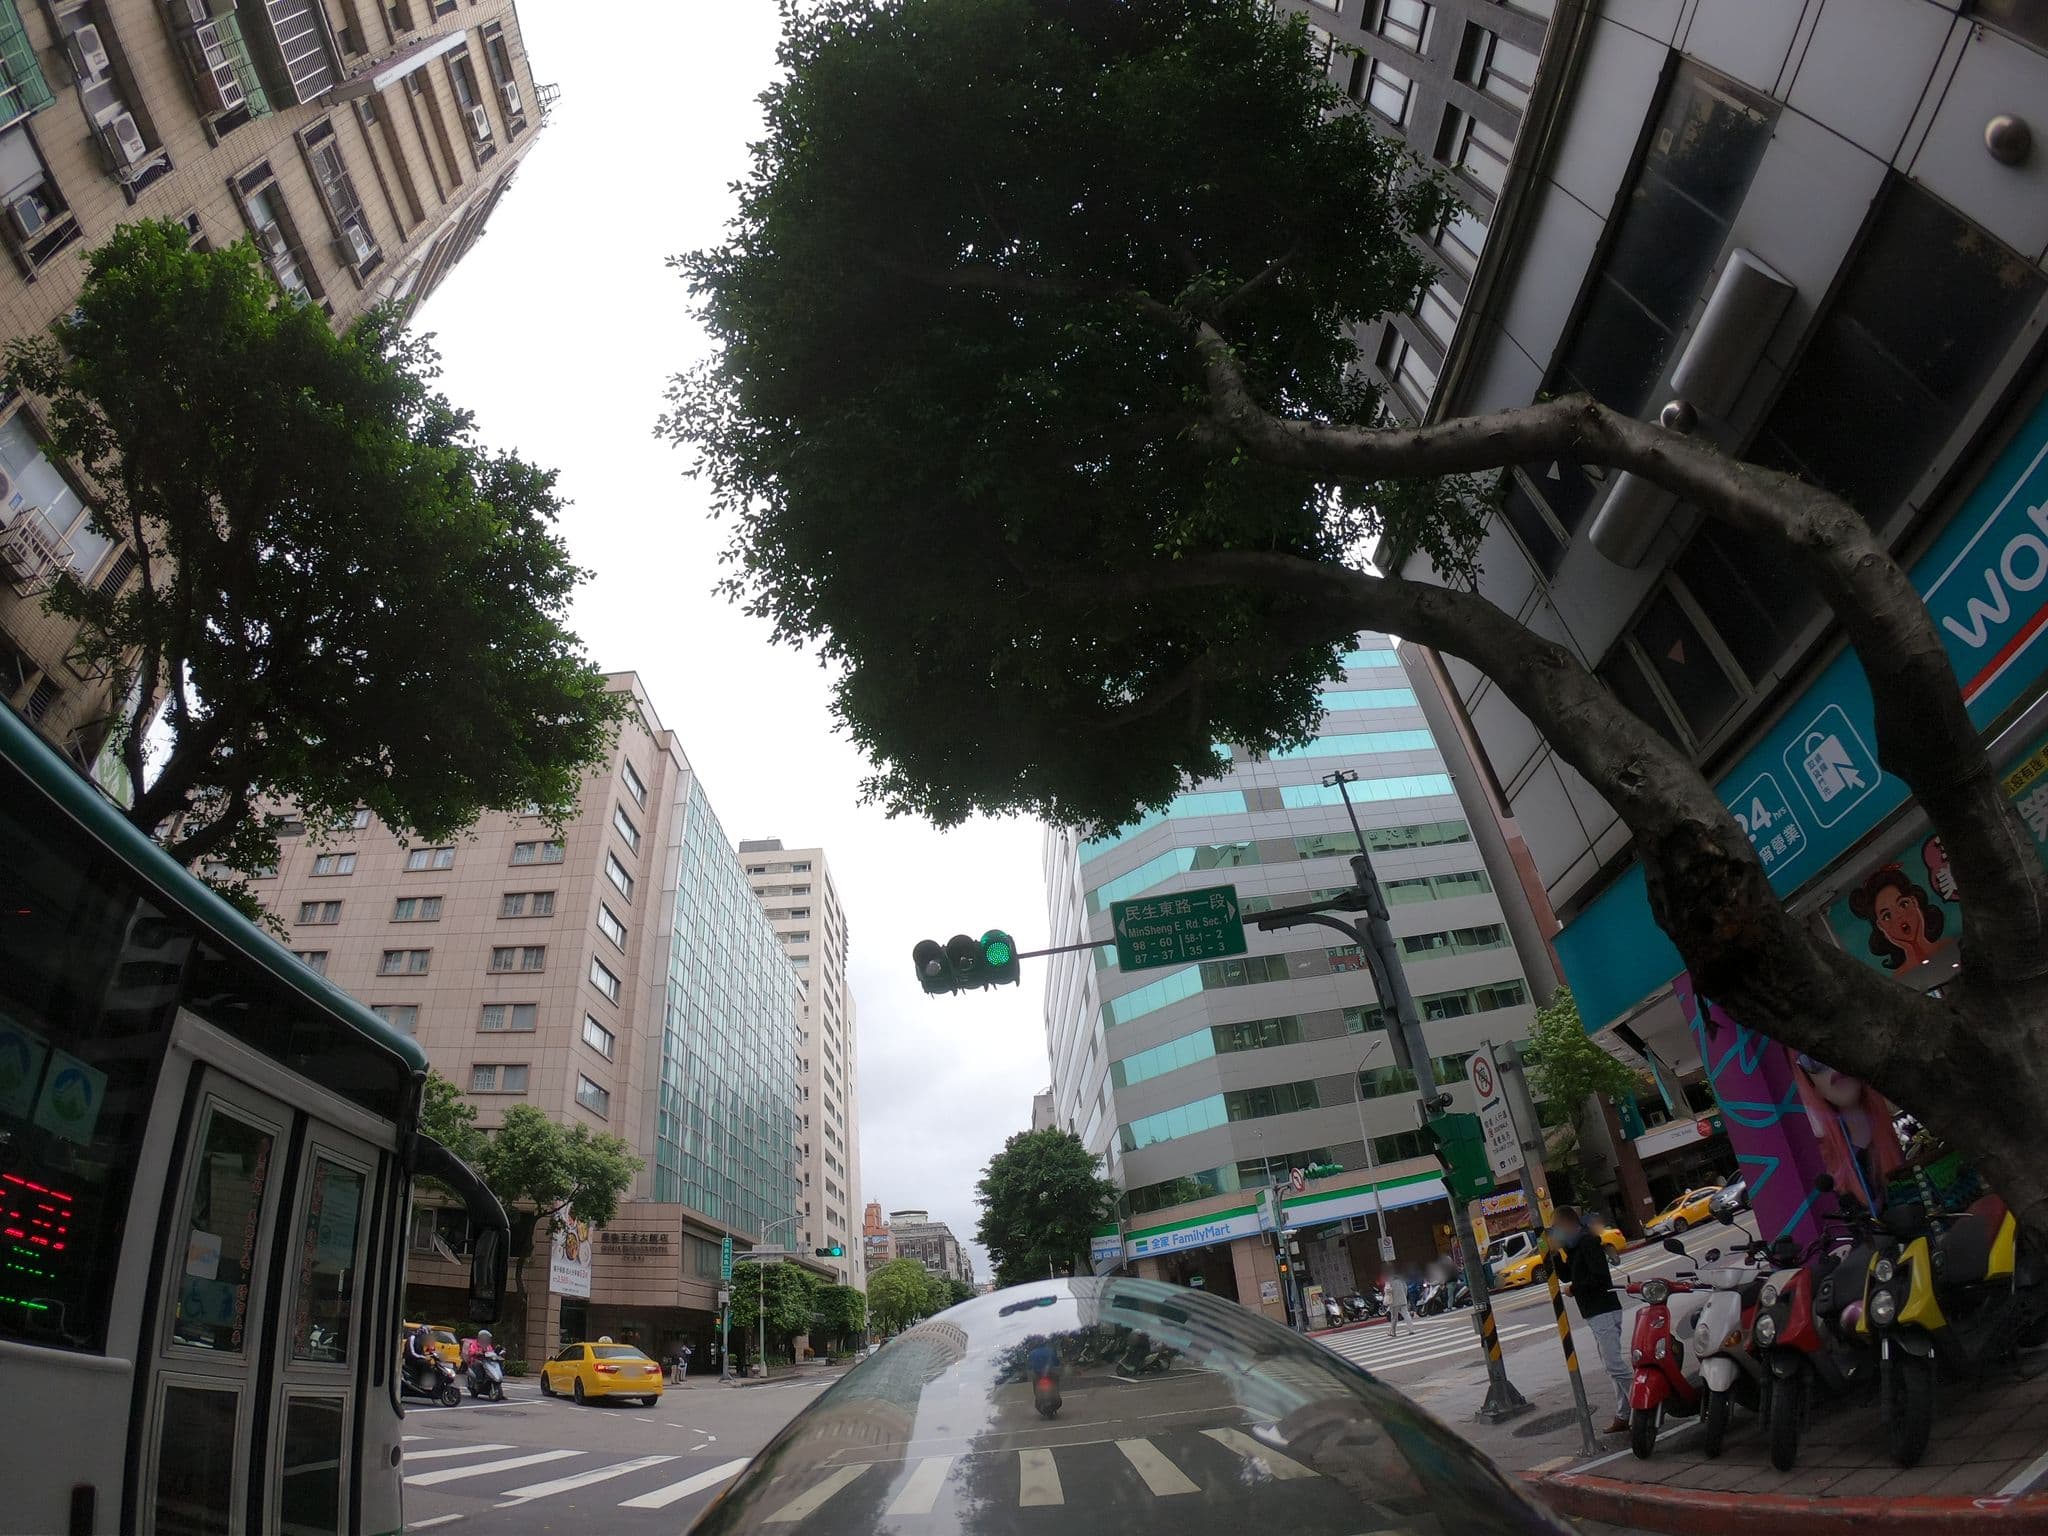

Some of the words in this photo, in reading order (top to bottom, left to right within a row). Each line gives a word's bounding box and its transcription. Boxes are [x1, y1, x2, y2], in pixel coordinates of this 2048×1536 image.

[1772, 806, 1787, 820] hrs
[1125, 894, 1226, 922] 民生東路一段
[1128, 924, 1173, 938] MinSheng
[1186, 919, 1200, 930] Rd.
[1203, 916, 1222, 927] Sec.
[1223, 914, 1229, 923] 1
[1185, 933, 1203, 944] 58-1
[1216, 930, 1223, 939] 2
[1132, 940, 1146, 951] 98
[1160, 938, 1173, 948] 60
[1189, 945, 1203, 956] 35
[1219, 942, 1225, 951] 3
[1135, 954, 1148, 964] 87
[1162, 950, 1174, 960] 37
[1151, 1236, 1170, 1250] 全家
[1172, 1223, 1231, 1246] FamilyMart
